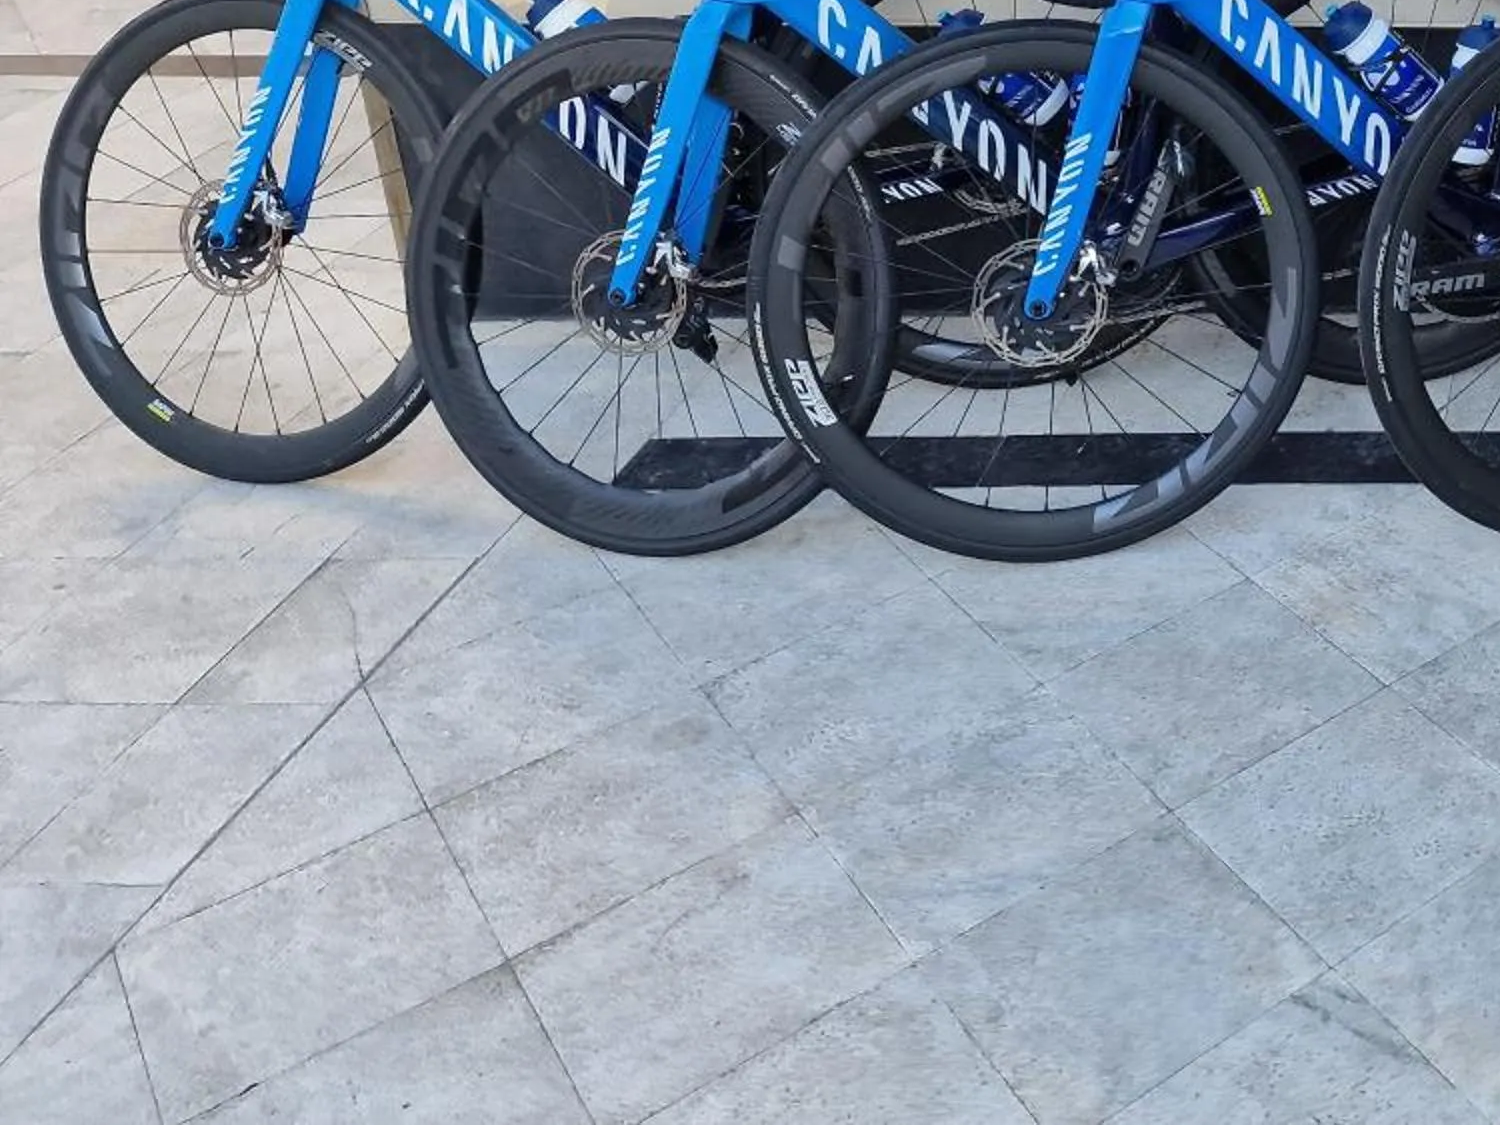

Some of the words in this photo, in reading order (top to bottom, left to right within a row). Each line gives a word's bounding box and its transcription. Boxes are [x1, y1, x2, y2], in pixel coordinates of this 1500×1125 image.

[221, 84, 272, 205] CANYON
[616, 126, 671, 267] CANYON
[1033, 132, 1094, 277] CANYON
[1411, 273, 1486, 298] RAM
